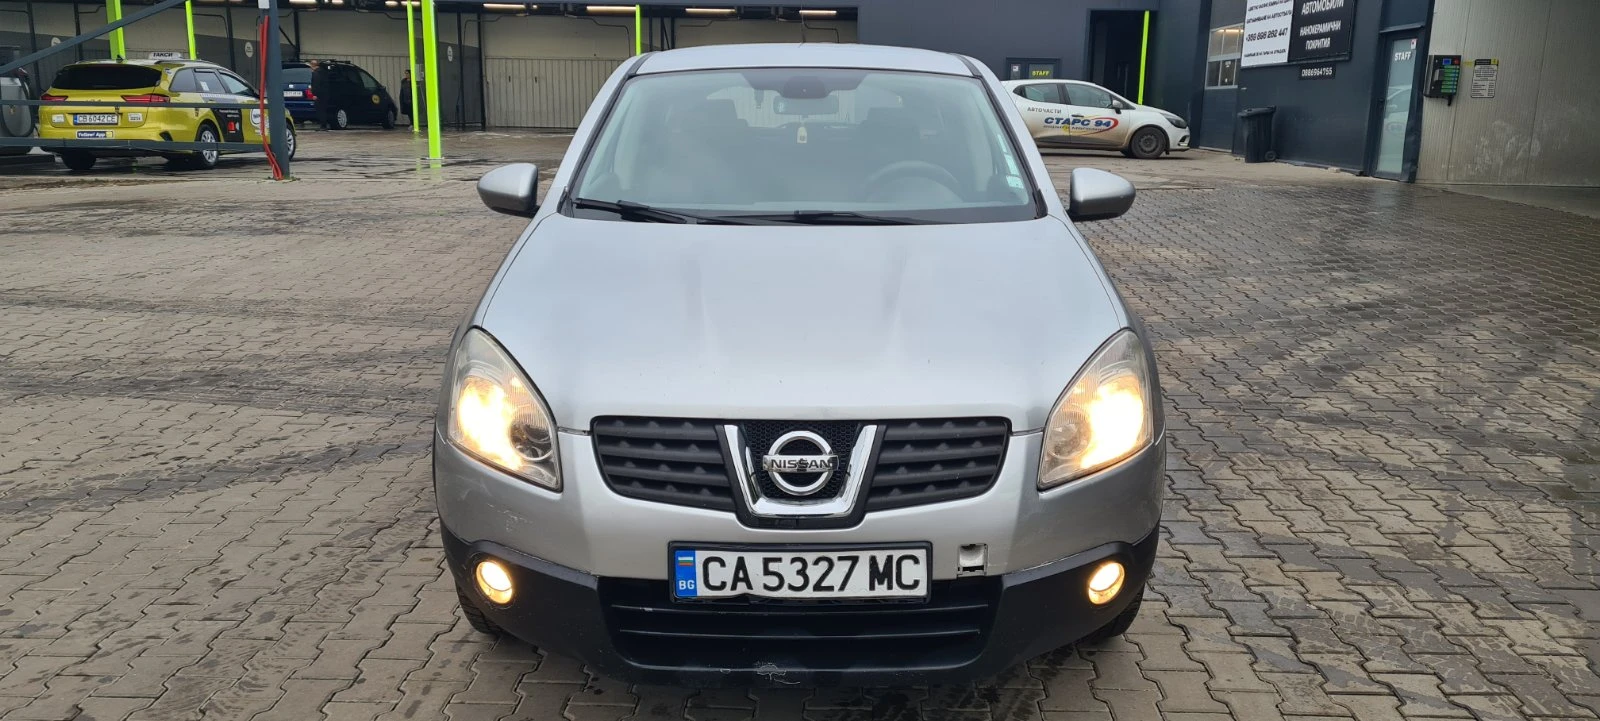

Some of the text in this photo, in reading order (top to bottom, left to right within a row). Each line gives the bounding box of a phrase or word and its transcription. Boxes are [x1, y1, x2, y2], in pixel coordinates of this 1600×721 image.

[1301, 0, 1344, 15] АВТОМОБИЛИ
[1300, 20, 1342, 36] НАНОКЕРАМИЧНИ
[1306, 37, 1331, 50] ПОКРИТИЯ
[1395, 51, 1411, 61] STAFF
[1027, 106, 1062, 114] АВТОЧАСТИ
[1044, 116, 1112, 128] СТАРС 94
[770, 458, 831, 470] NISSAN
[678, 555, 920, 592] BG CA 5327 MC
